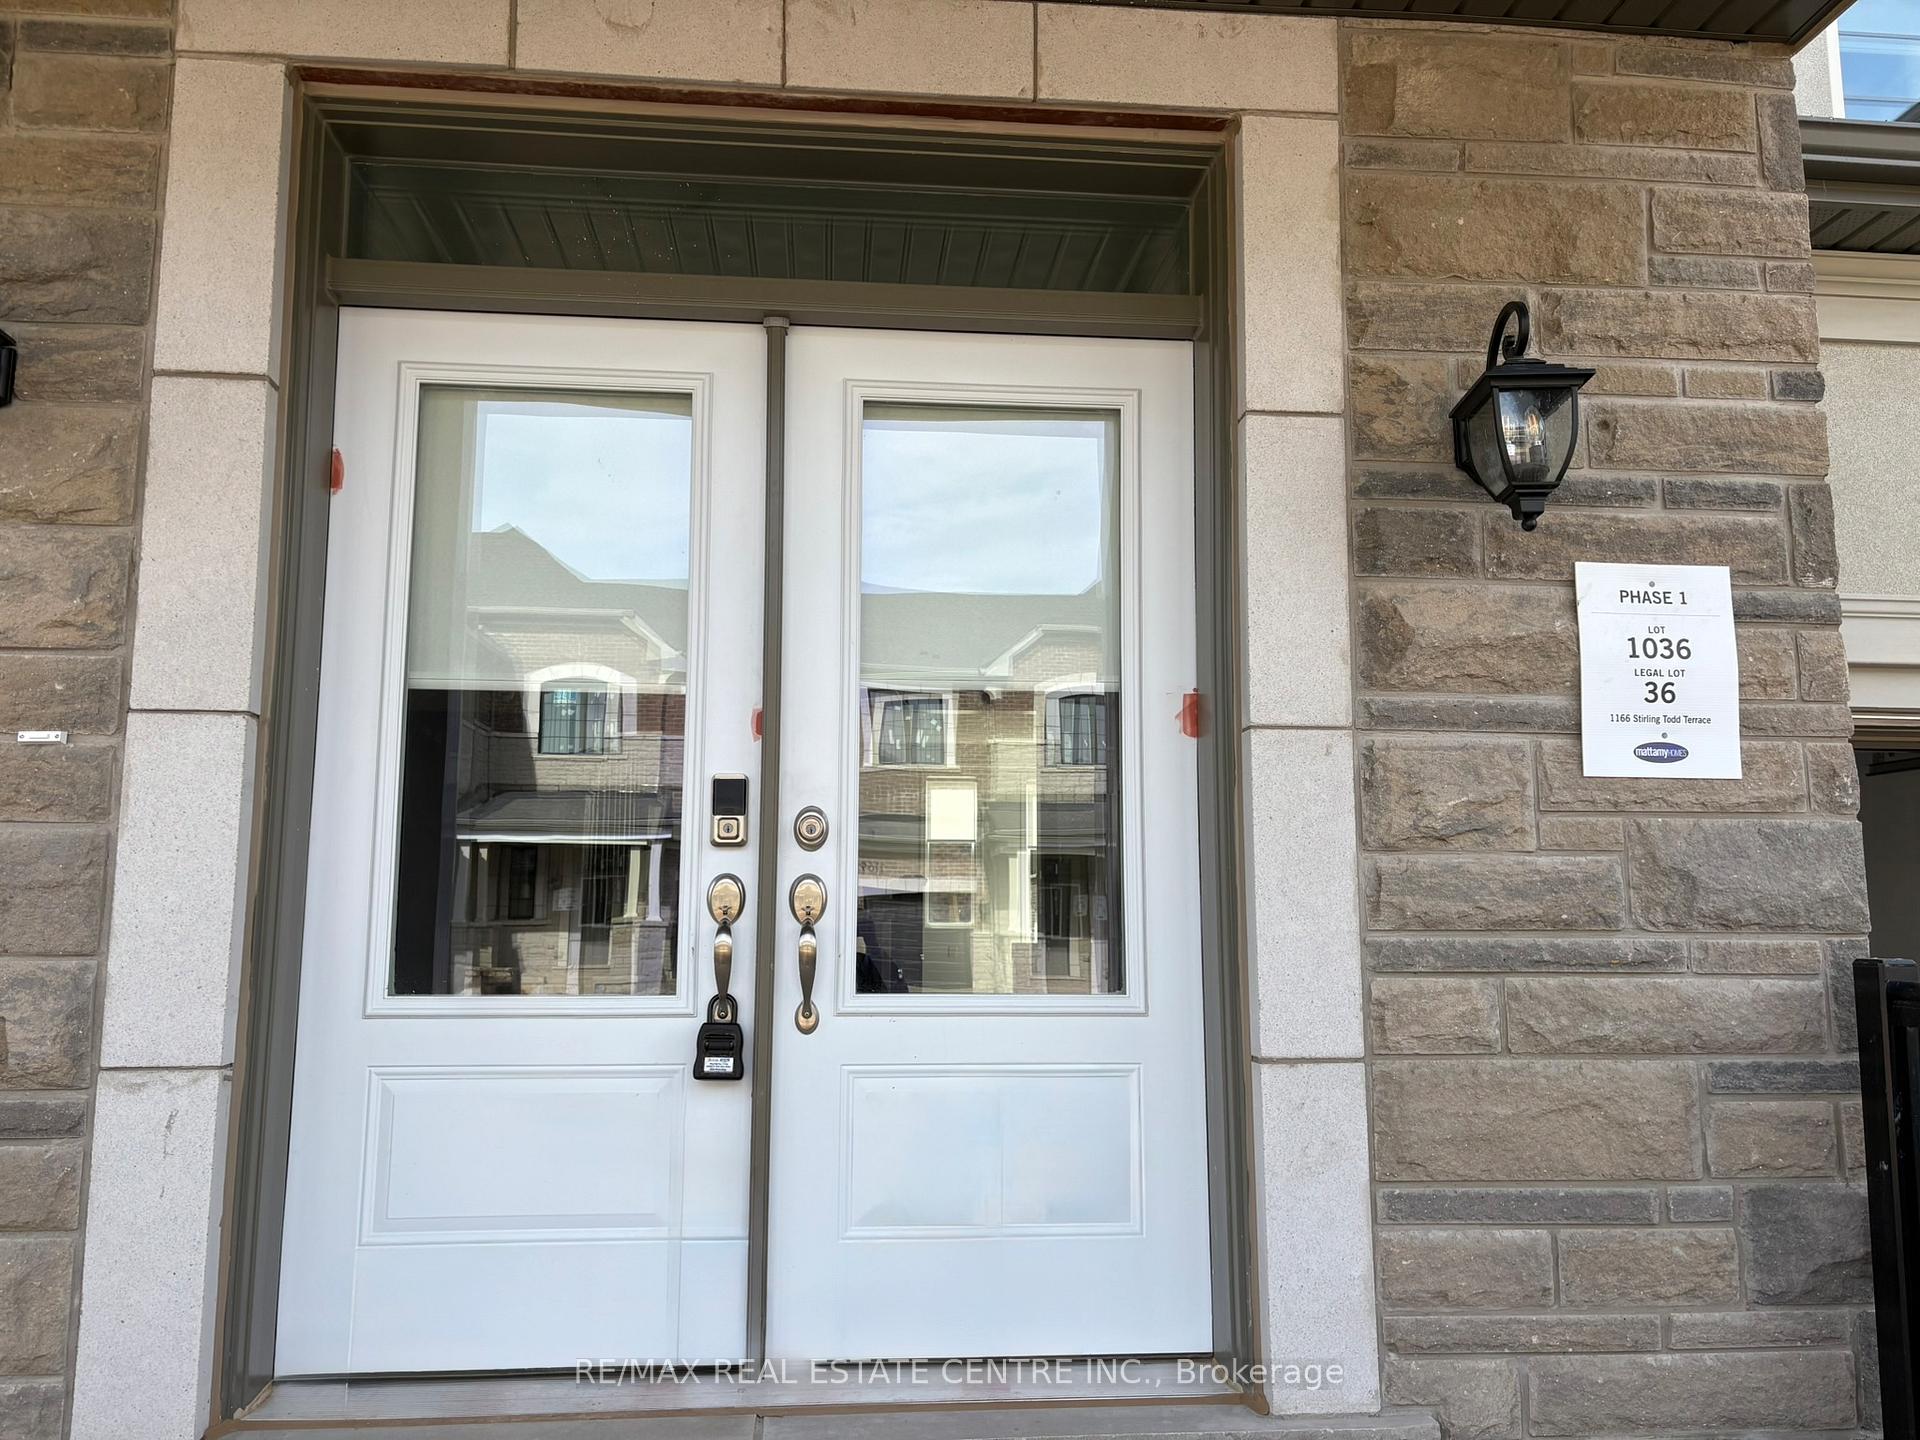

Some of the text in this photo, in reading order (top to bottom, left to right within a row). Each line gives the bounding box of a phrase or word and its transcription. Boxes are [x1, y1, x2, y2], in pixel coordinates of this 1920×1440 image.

[1619, 590, 1688, 605] PHASE 1
[1648, 626, 1666, 634] LOT
[1627, 637, 1692, 660] 1036
[1634, 669, 1686, 678] LEGAL LOT
[1644, 681, 1676, 704] 36
[1610, 713, 1712, 726] 1166 Stirling Todd Terrace
